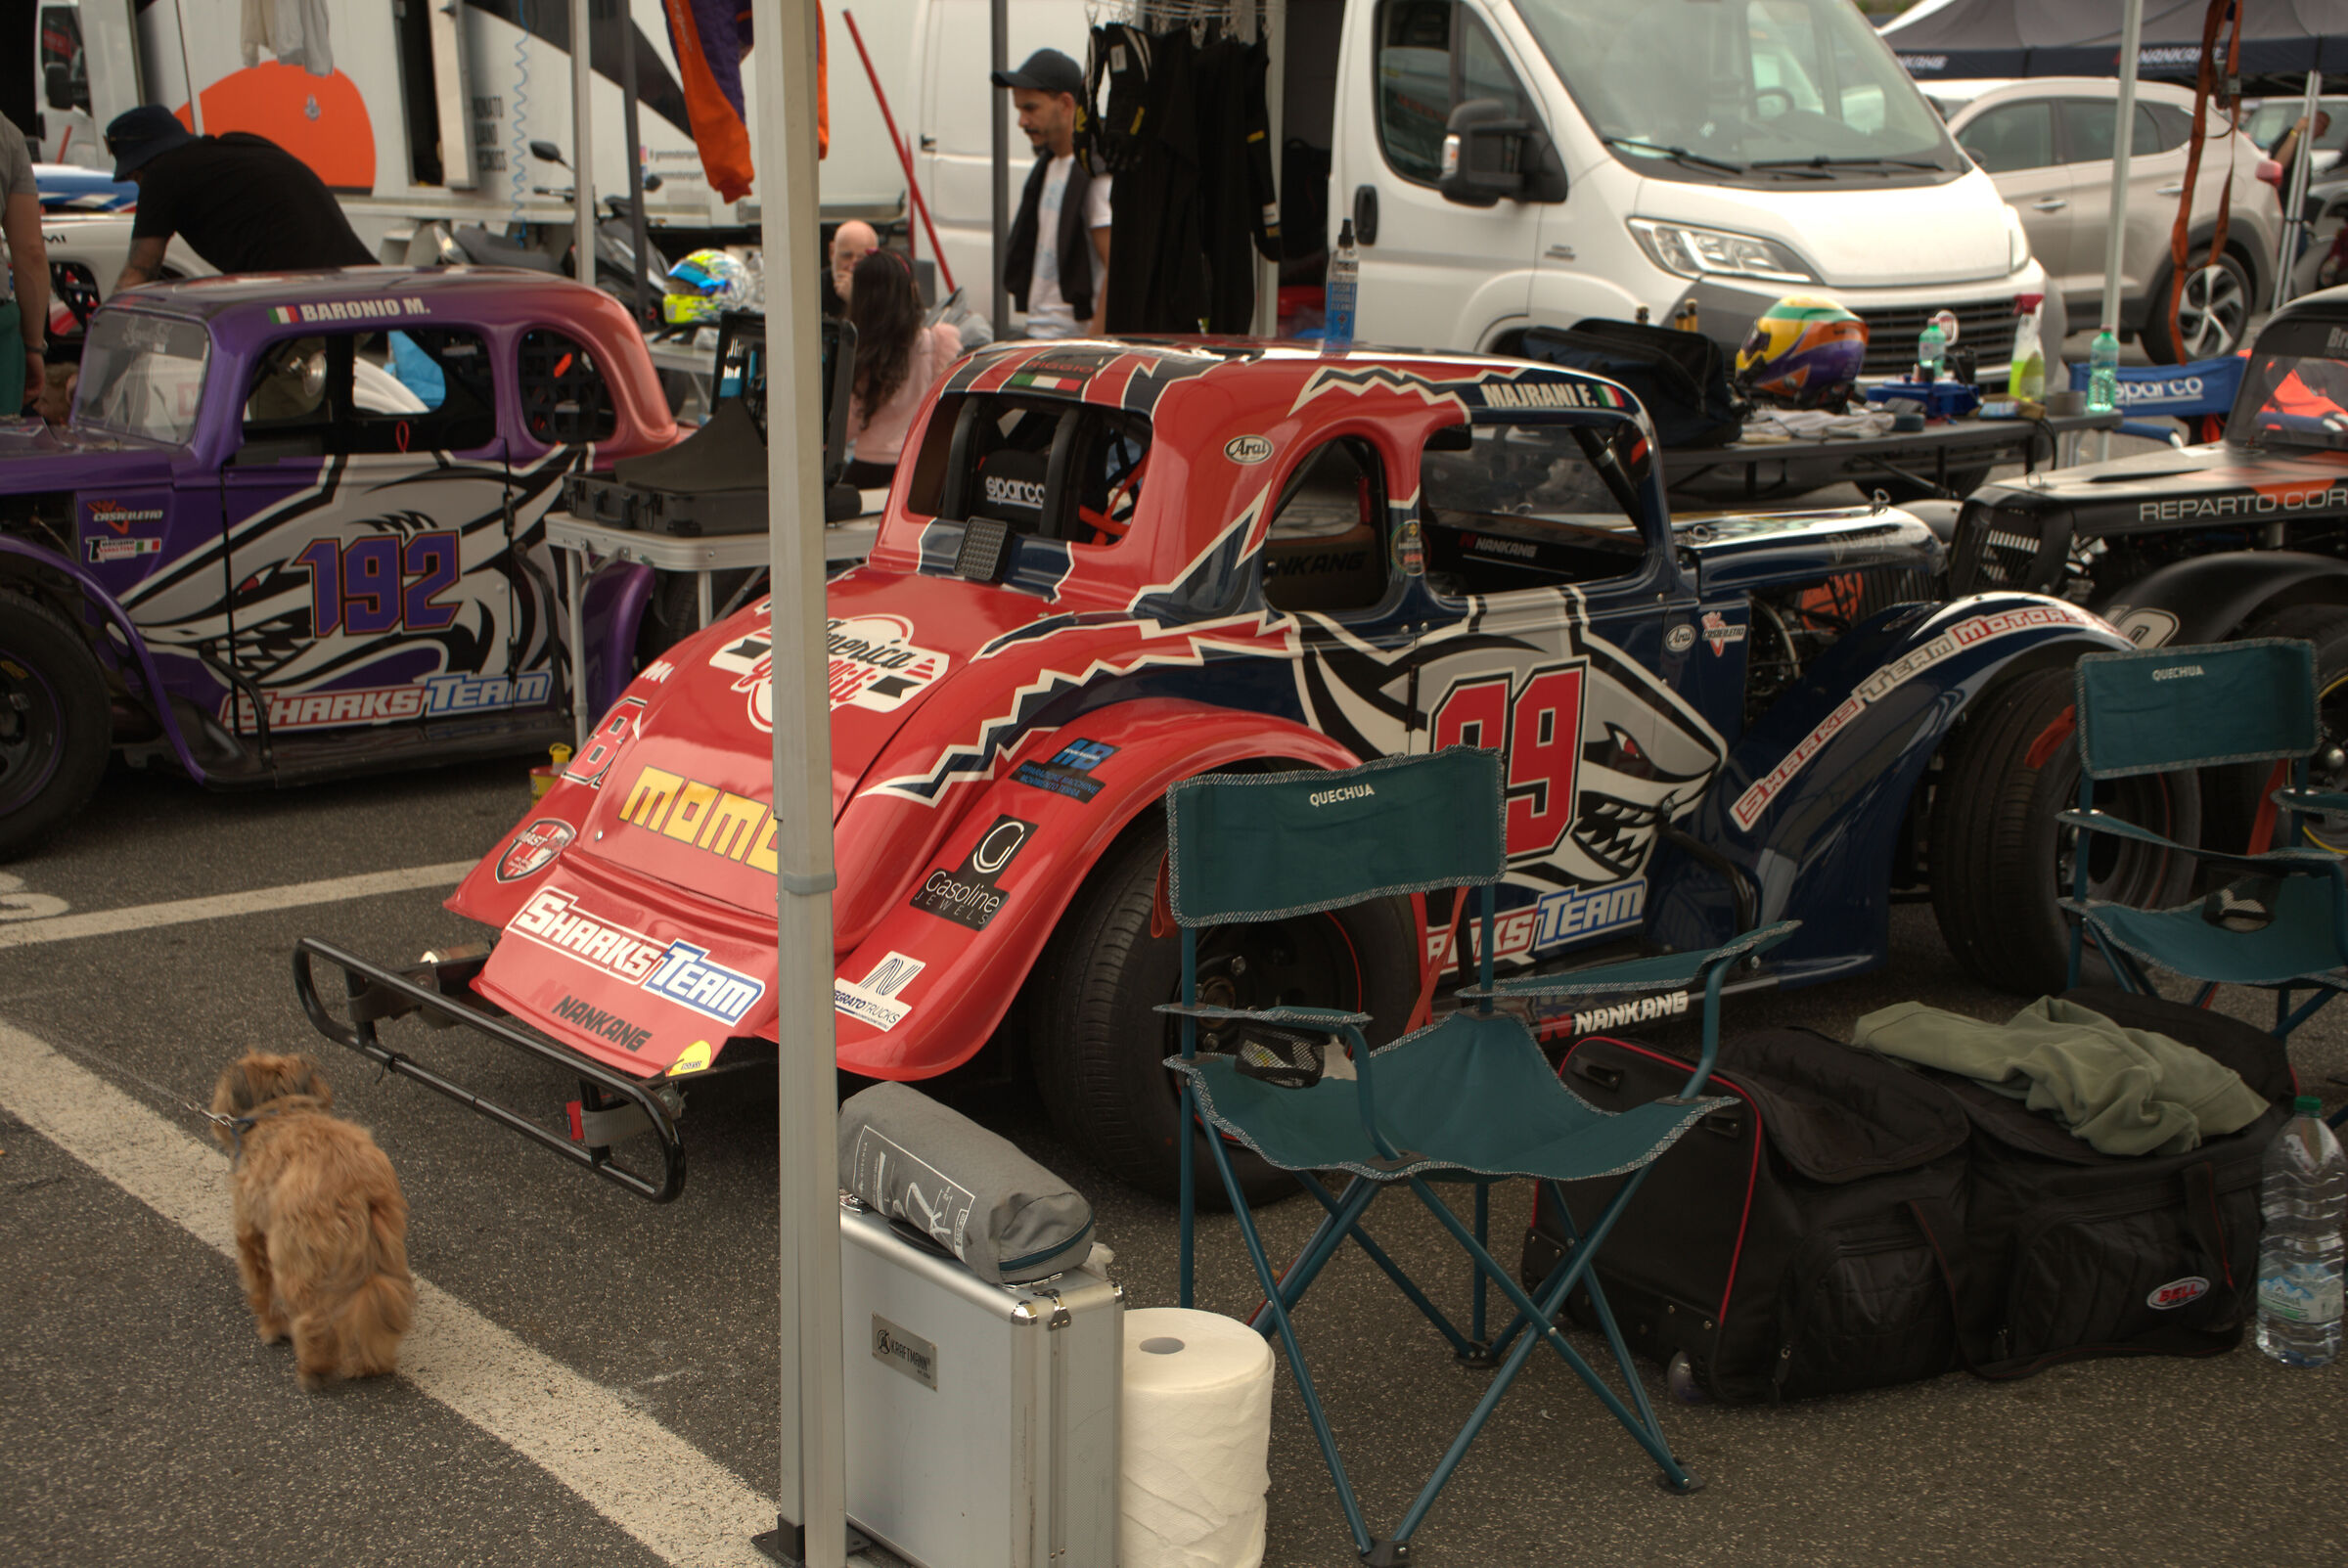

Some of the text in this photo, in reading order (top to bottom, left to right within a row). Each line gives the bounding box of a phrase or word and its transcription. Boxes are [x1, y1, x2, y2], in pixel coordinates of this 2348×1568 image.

[299, 296, 431, 322] BARONIO M.
[1028, 359, 1095, 375] RIGGIO
[1478, 382, 1579, 408] MAJRANI
[2140, 493, 2278, 521] REPARTO
[1474, 536, 1538, 559] NANKANG
[294, 529, 463, 639] 192
[2151, 664, 2205, 682] QUECHUA
[235, 674, 551, 730] SHARKS TEAM
[1735, 697, 1859, 828] SHARKS
[1860, 633, 1956, 703] TEAM
[1309, 782, 1376, 807] QUECHUA
[914, 890, 989, 925] JEWELS
[926, 871, 1000, 914] Gasoline
[1539, 883, 1645, 941] TEAM
[515, 892, 759, 1018] SHARKS TEAM
[551, 995, 654, 1053] NANKANG
[835, 990, 901, 1025] EGRATOTRUCKS
[1573, 990, 1690, 1036] NANKANG
[2158, 1282, 2198, 1303] BELL
